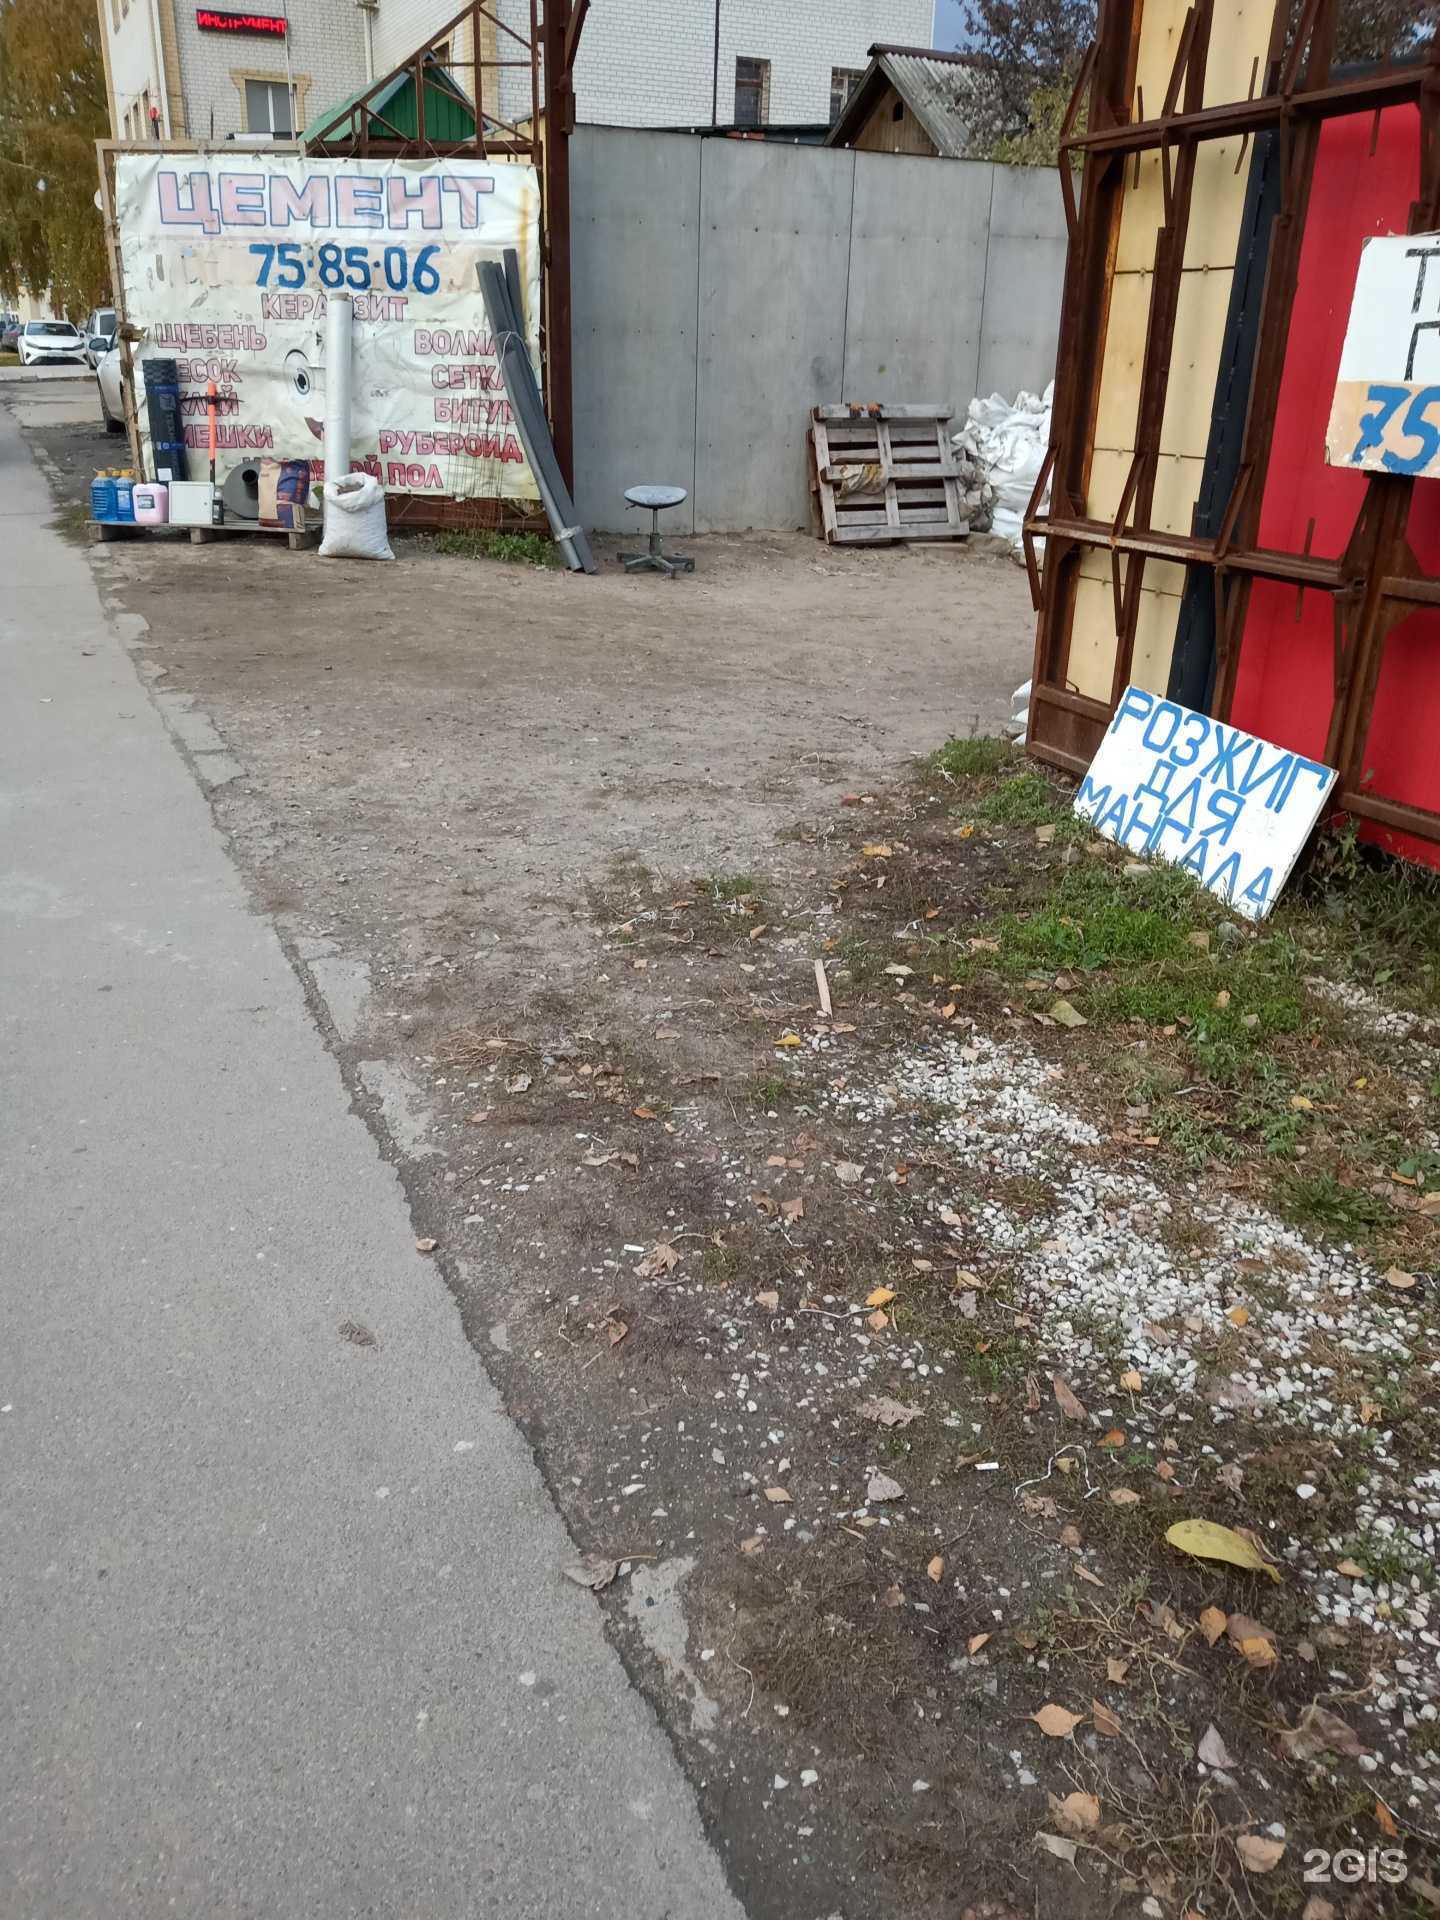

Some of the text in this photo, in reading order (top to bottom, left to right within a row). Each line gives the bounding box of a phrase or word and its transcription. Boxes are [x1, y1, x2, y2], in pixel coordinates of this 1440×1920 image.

[157, 171, 495, 235] ЦЕМЕНТ
[261, 292, 409, 321] КЕРАЗИТ
[155, 323, 267, 353] ЩЕБЕНЬ
[153, 357, 242, 383] ЕСОК
[379, 429, 523, 463] РУБЕРОИД
[387, 462, 444, 488] ПОЛ
[1111, 686, 1332, 814] РОЗЖИГ
[1133, 758, 1247, 846] ДЛЯ
[1078, 776, 1274, 920] МАНГАЛА
